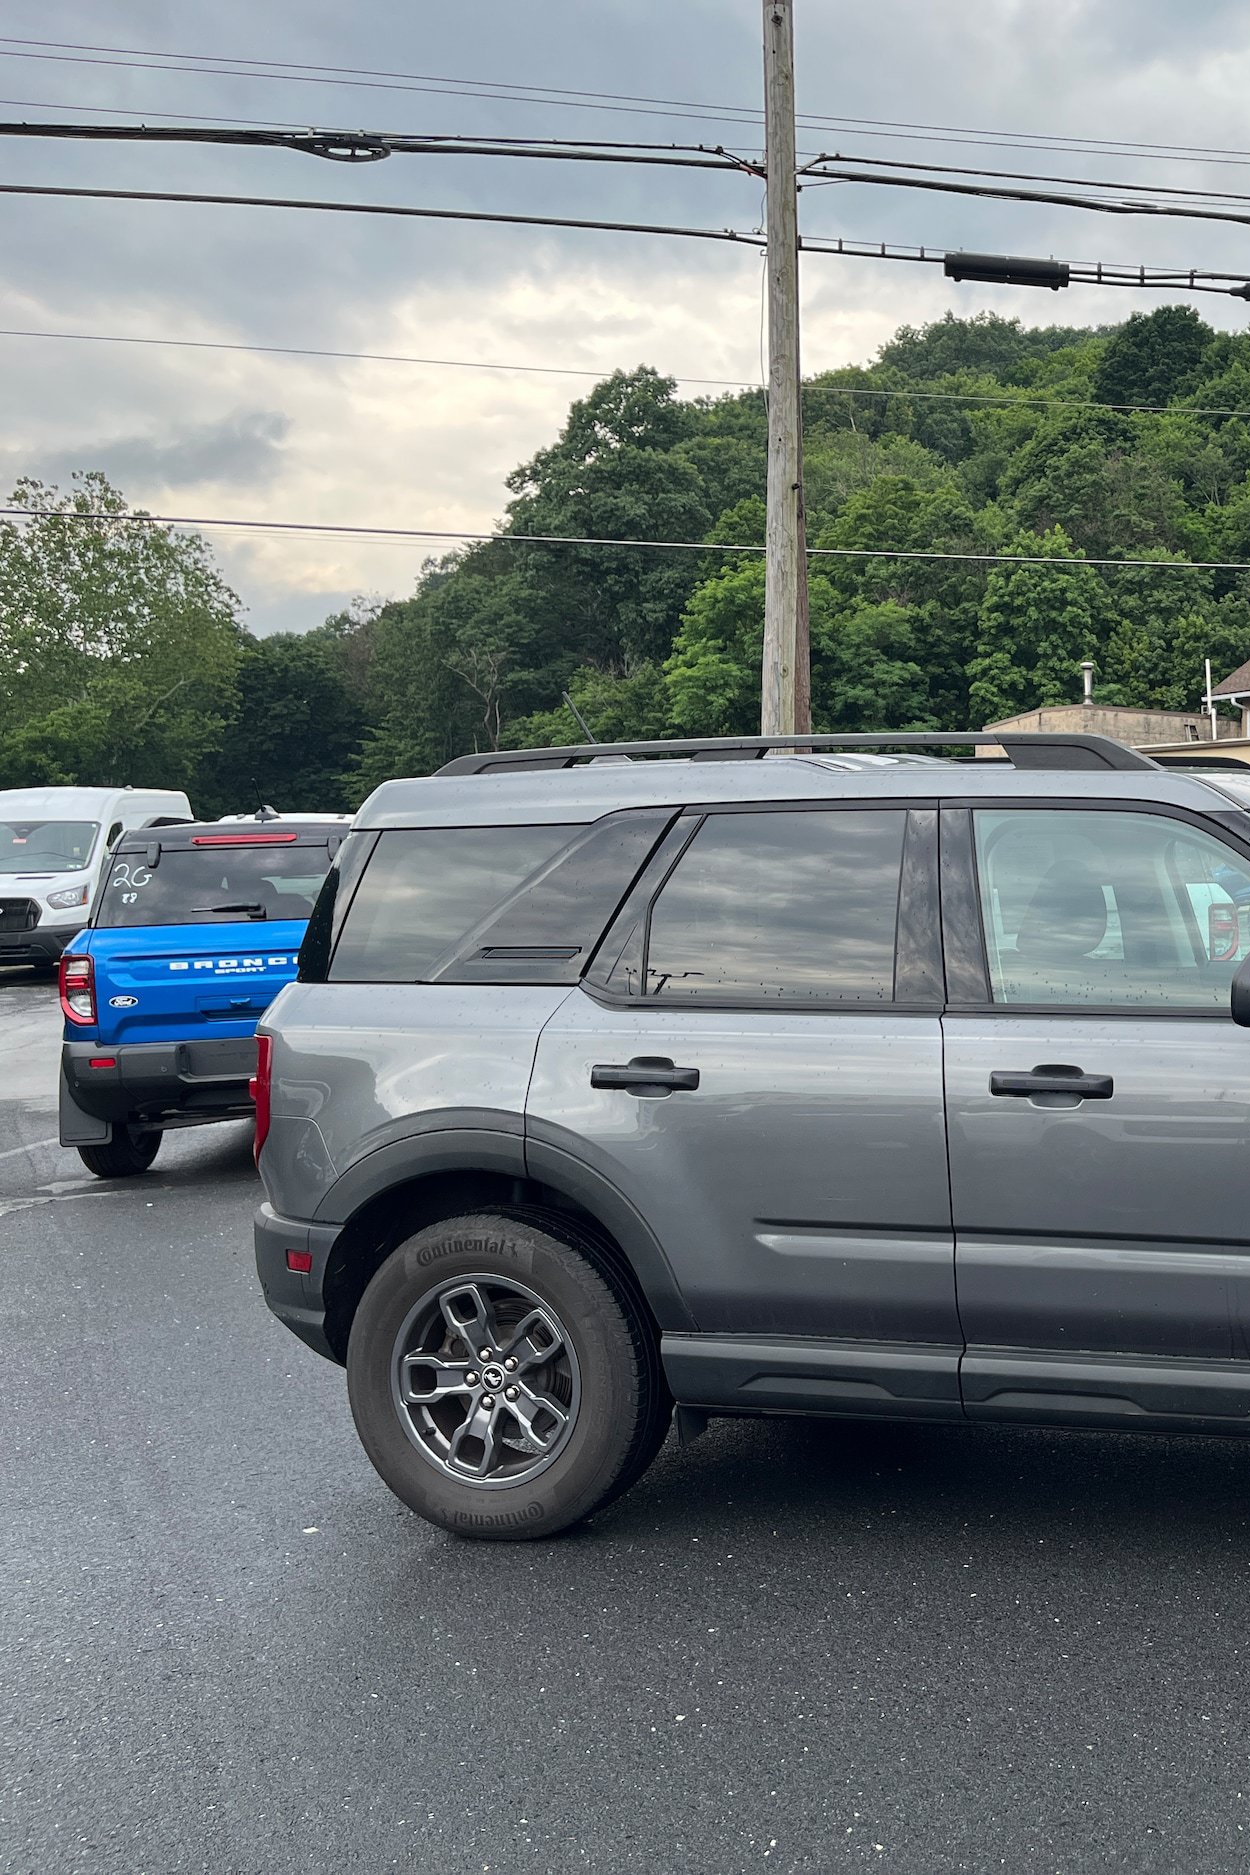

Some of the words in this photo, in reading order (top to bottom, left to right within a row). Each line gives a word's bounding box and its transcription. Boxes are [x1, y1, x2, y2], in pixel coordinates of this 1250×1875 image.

[169, 956, 298, 970] BRONC
[214, 966, 266, 974] SPORT
[417, 1239, 506, 1267] Continental
[454, 1501, 544, 1529] Continental
